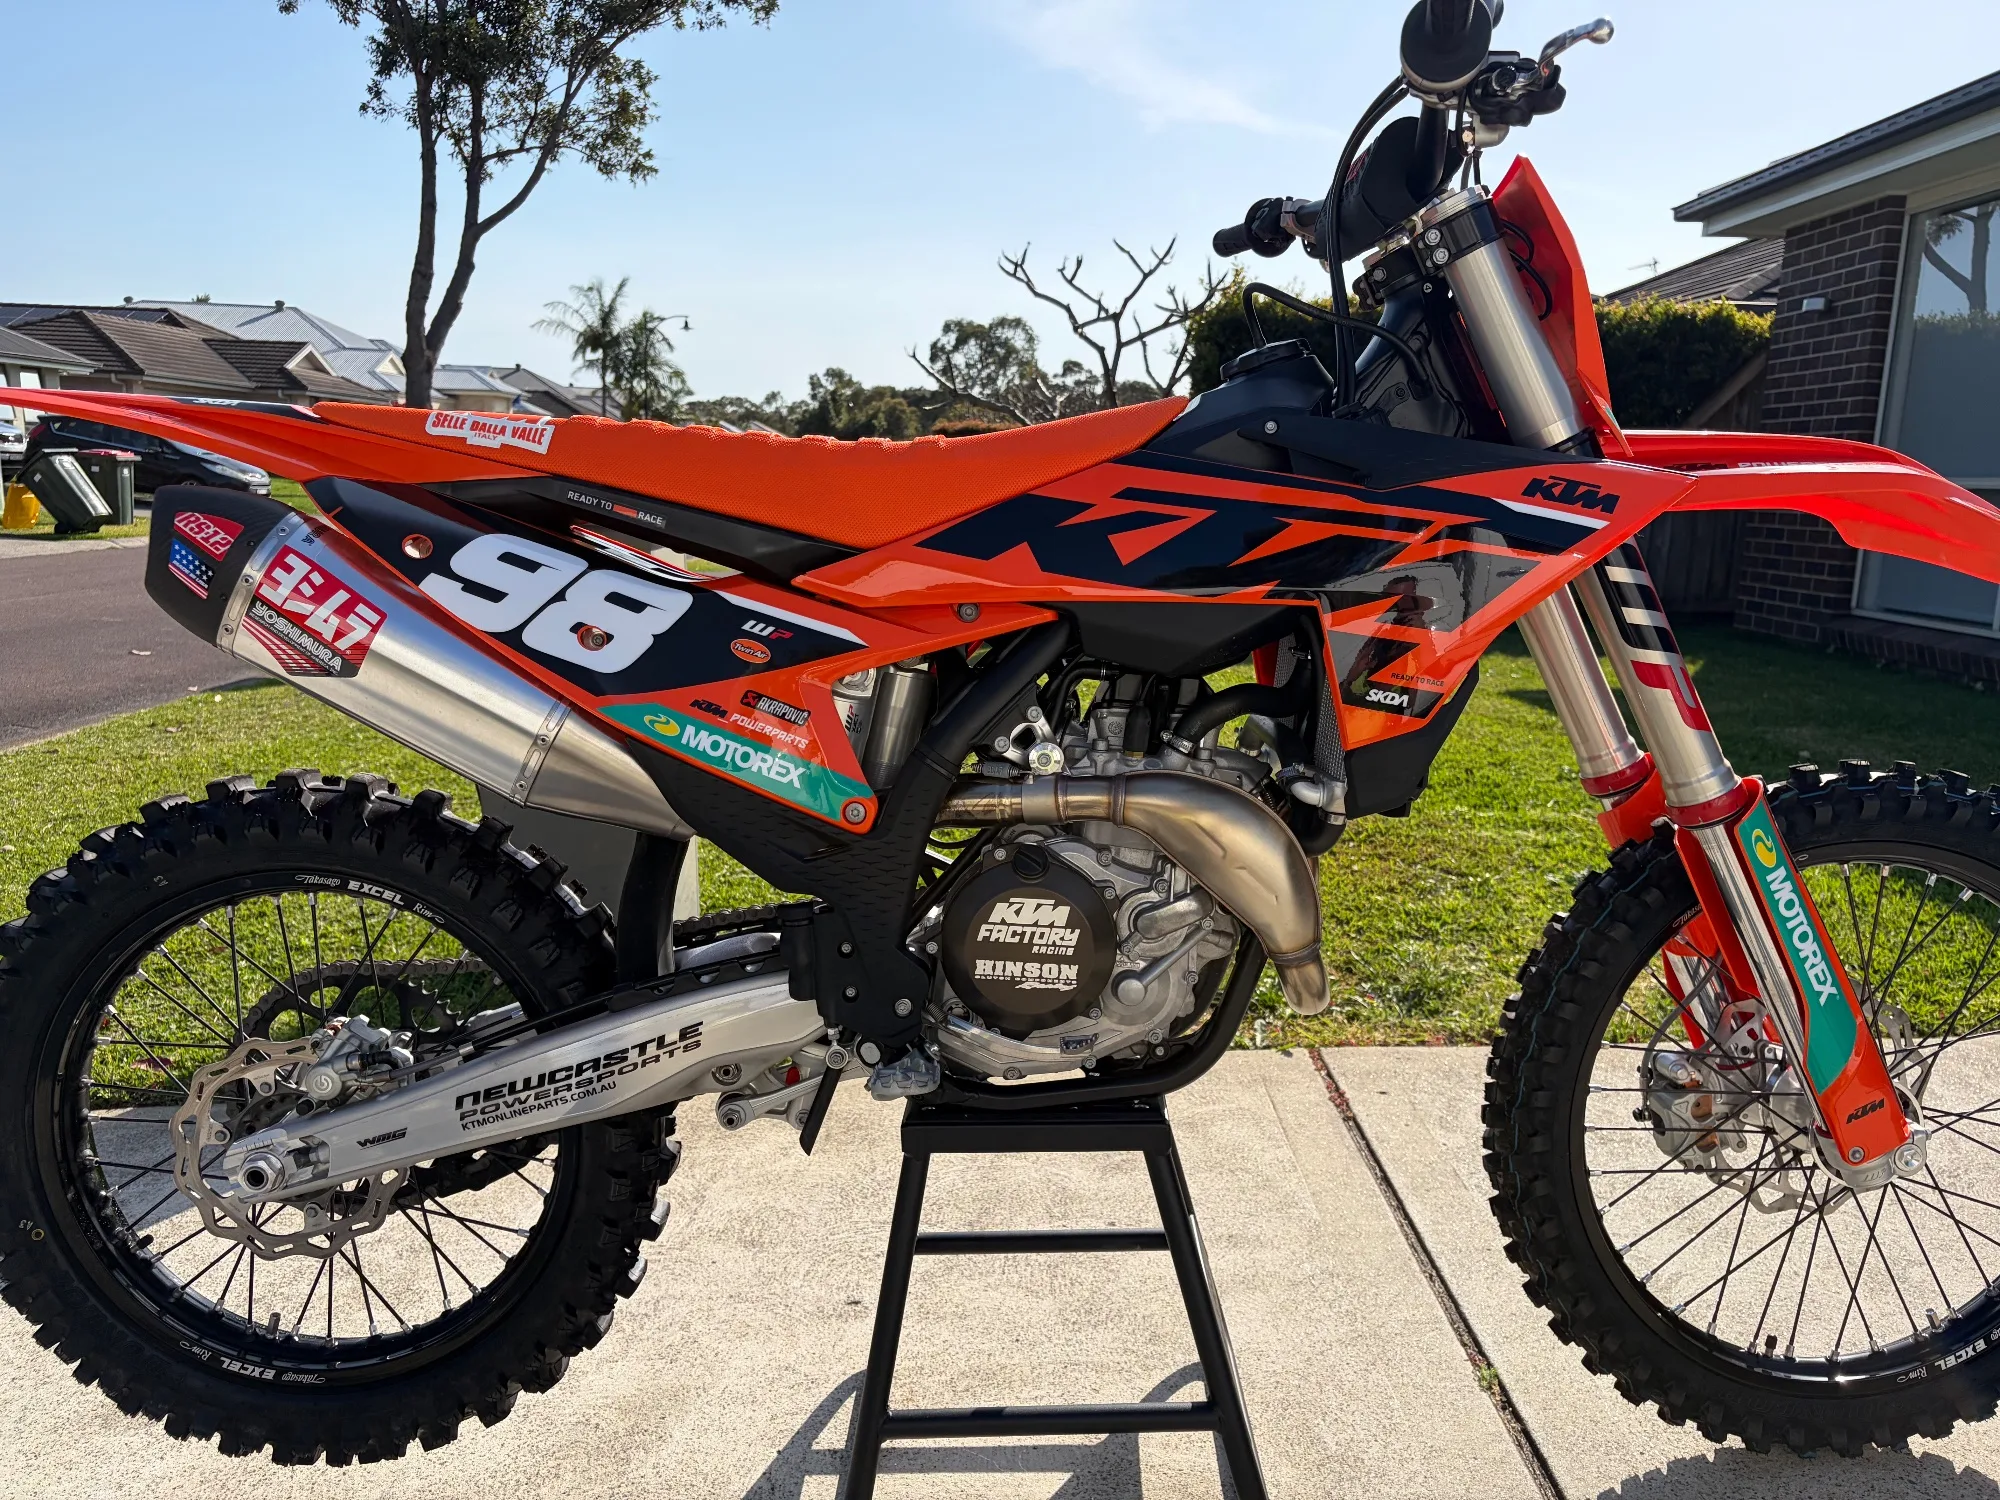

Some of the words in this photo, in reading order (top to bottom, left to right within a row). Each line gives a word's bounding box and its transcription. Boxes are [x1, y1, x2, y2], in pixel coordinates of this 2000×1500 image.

[432, 412, 468, 430] SELLE
[470, 420, 507, 436] DALLA
[511, 426, 547, 445] VALLE
[474, 432, 499, 441] ITALY
[567, 491, 599, 506] READY
[600, 500, 613, 510] TO
[638, 511, 663, 525] RACE
[1521, 475, 1620, 514] KTM
[258, 553, 381, 651] ヨシムラ
[419, 533, 693, 674] 98
[252, 600, 342, 671] YOSHIMURA
[741, 620, 794, 639] WP
[734, 643, 754, 655] Twin
[753, 650, 768, 659] Air
[1391, 672, 1414, 682] READY
[1426, 678, 1445, 686] RACE
[689, 699, 728, 718] KTM
[1365, 688, 1409, 707] SKDA
[730, 713, 809, 749] POWERPARTS
[681, 725, 808, 789] MOTOREX
[295, 875, 341, 887] Takasago
[347, 880, 405, 905] EXCEL
[413, 903, 445, 924] Rim
[988, 897, 1071, 926] KTM
[977, 924, 1081, 946] FACTORY
[1765, 865, 1839, 1007] MOTOREX
[1031, 945, 1075, 956] RACING
[975, 959, 1078, 980] HINSON
[455, 1020, 704, 1111] NEWCASTLE
[459, 1039, 703, 1122] POWERSPORTS
[461, 1081, 618, 1131] KTMONLINEPARTS.COM.AU
[1846, 1098, 1884, 1124] KTM
[180, 1340, 212, 1361] Rim
[1934, 1338, 1988, 1371] EXCEL
[220, 1356, 277, 1381] EXCEL
[281, 1371, 326, 1384] Takasago
[1896, 1366, 1928, 1383] Rim
